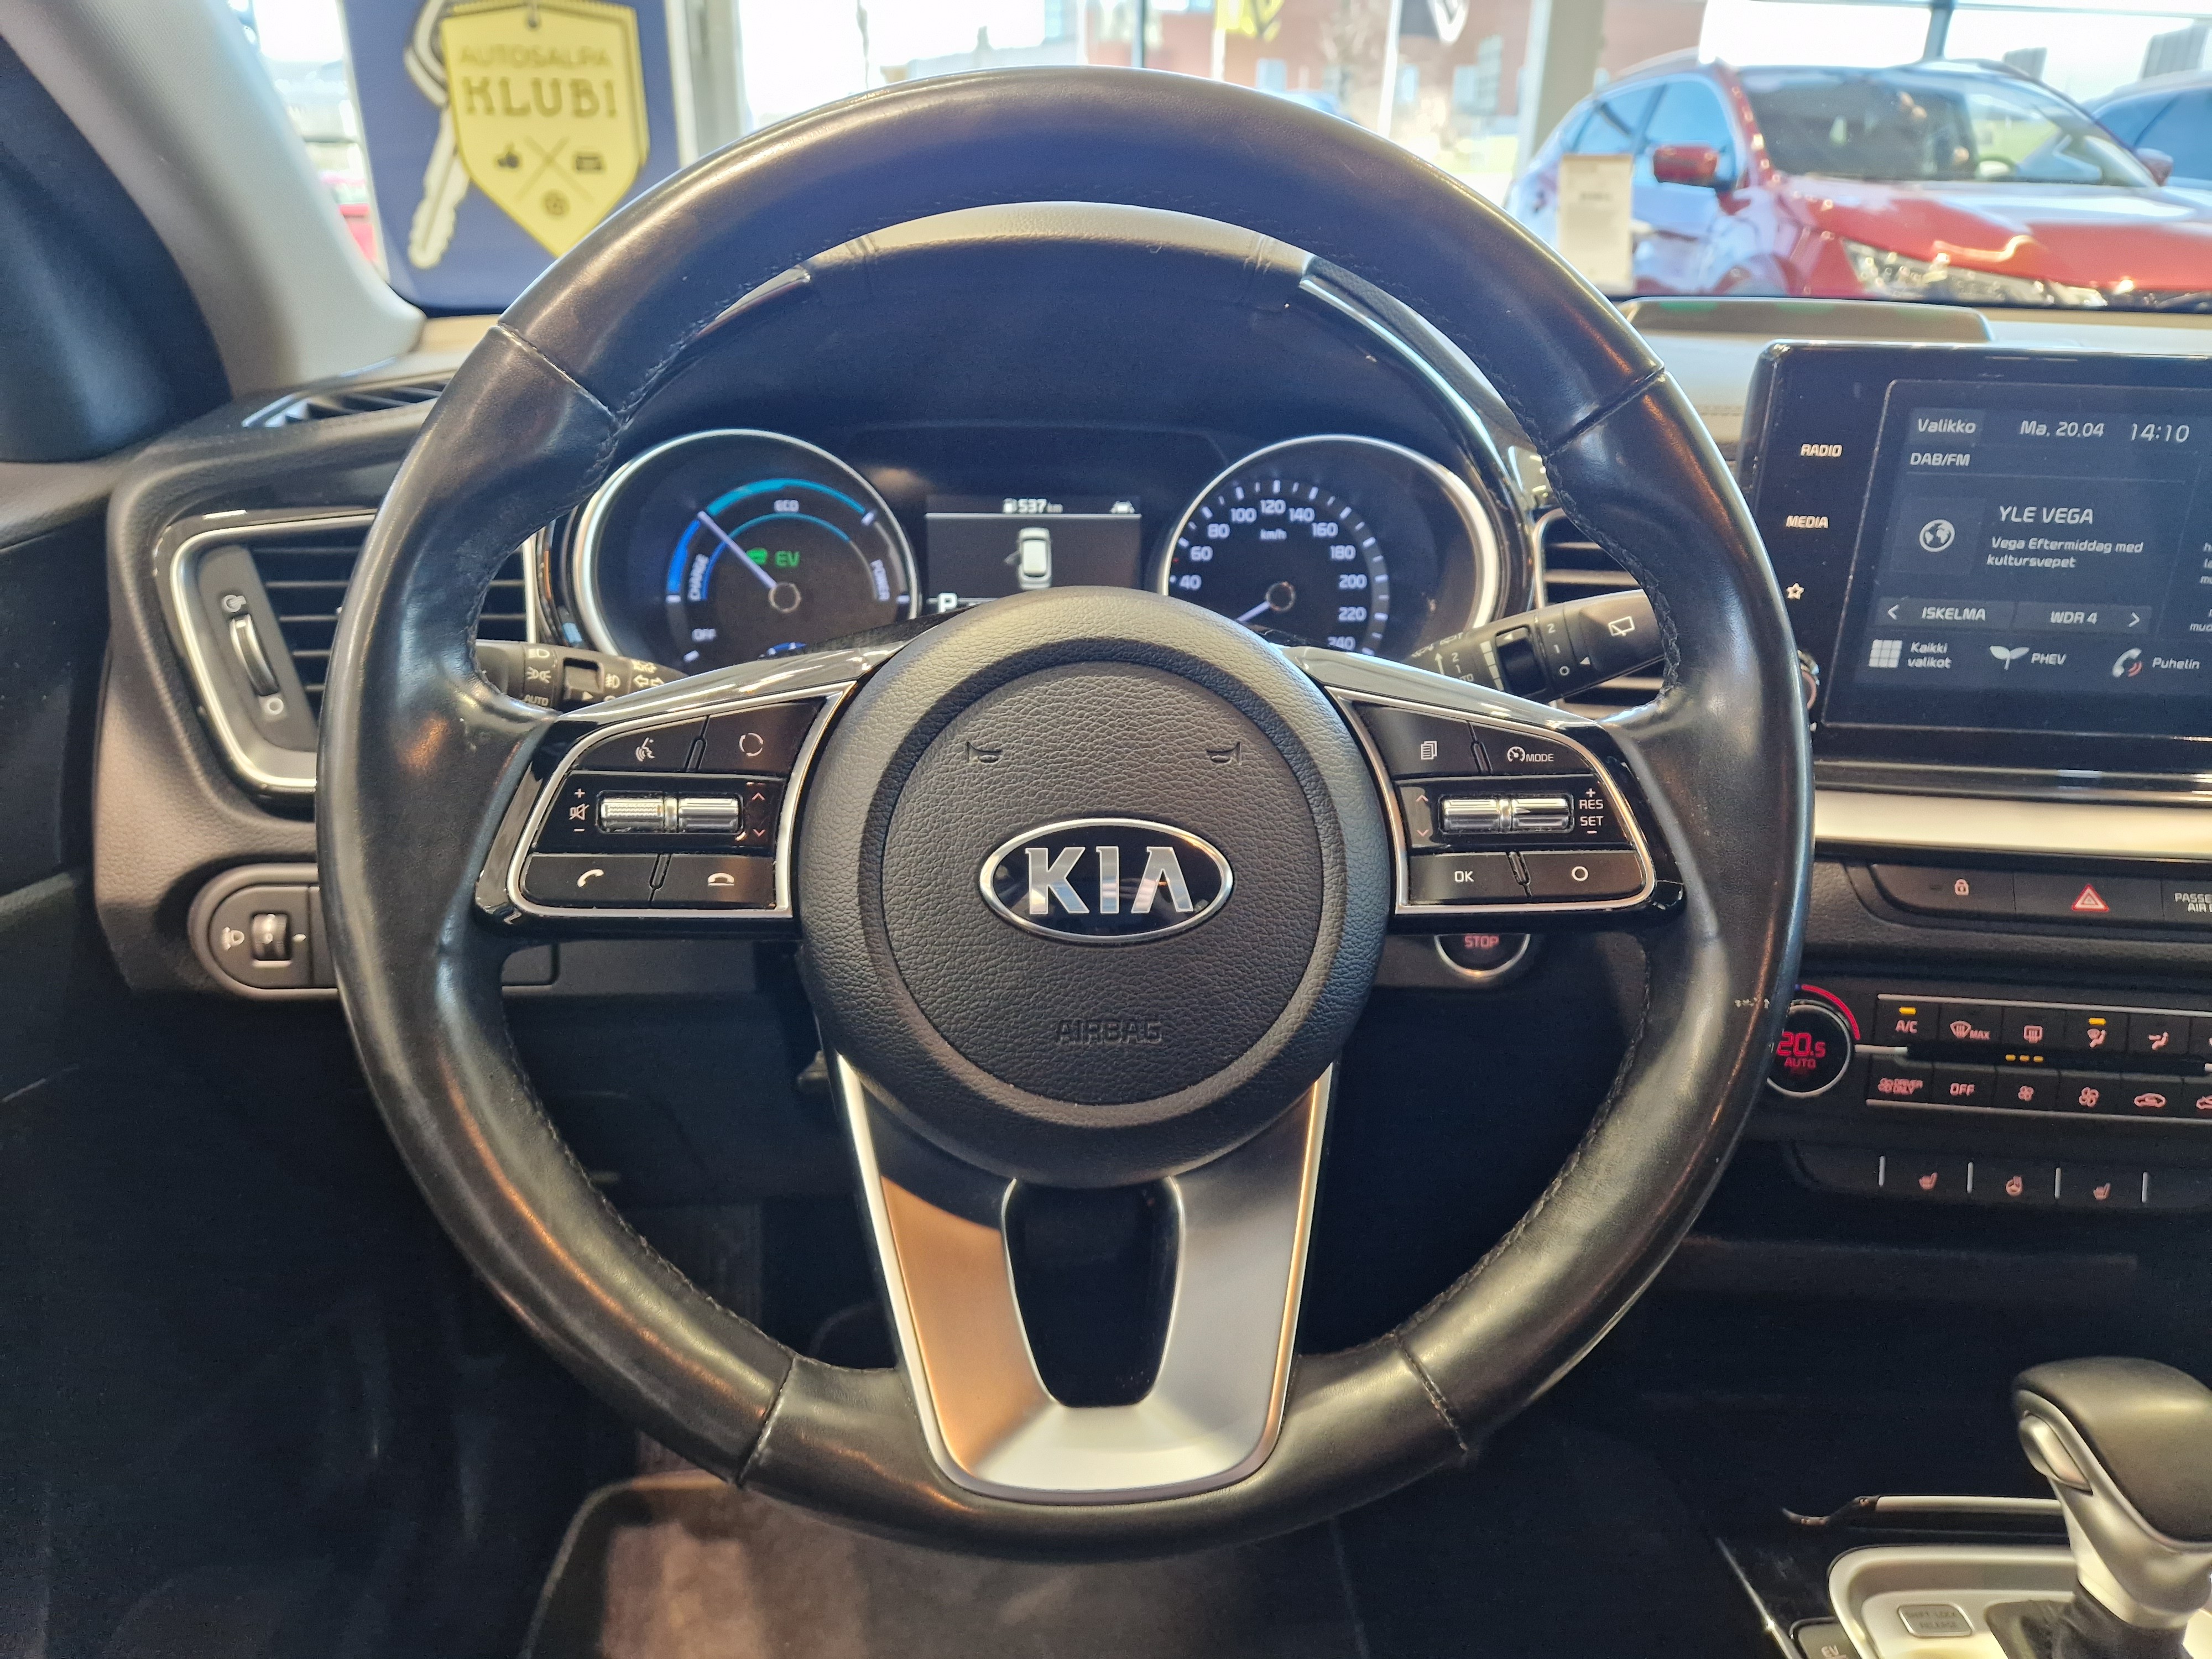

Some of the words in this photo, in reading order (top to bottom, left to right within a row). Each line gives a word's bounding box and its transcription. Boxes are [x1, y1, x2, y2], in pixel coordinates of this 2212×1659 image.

[462, 76, 617, 118] KLUBI
[1918, 418, 1976, 434] Valikko
[2020, 420, 2051, 437] Ma.
[2056, 421, 2105, 437] 20.04
[2131, 422, 2190, 443] 14:10
[1800, 444, 1843, 457] RADIO
[1910, 452, 1971, 467] DAB/FM
[774, 499, 800, 513] ECO
[1018, 498, 1047, 513] 537
[1047, 502, 1063, 513] km
[1260, 499, 1286, 514] 120
[1230, 508, 1258, 523] 100
[1288, 507, 1315, 522] 140
[1785, 515, 1829, 529] MEDIA
[1999, 505, 2037, 523] YLE
[2042, 507, 2094, 525] VEGA
[1207, 523, 1230, 539] 80
[1260, 528, 1287, 540] km/h
[1311, 522, 1339, 538] 160
[1330, 545, 1357, 560] 180
[1991, 536, 2026, 551] Vega
[2028, 537, 2112, 554] Eftermiddag
[2115, 541, 2144, 554] med
[775, 551, 800, 567] EV
[1190, 545, 1213, 561] 60
[1986, 554, 2077, 569] kultursvepet
[1179, 575, 1202, 590] 40
[1338, 574, 1368, 589] 200
[938, 592, 957, 612] P
[1338, 607, 1367, 622] 220
[1922, 606, 1986, 621] ISKELMA
[2051, 611, 2084, 624] WDR
[2087, 612, 2098, 624] 4
[692, 628, 717, 642] OFF
[1547, 623, 1556, 634] 2
[1553, 644, 1560, 654] 1
[1911, 641, 1948, 654] Kaikki
[1451, 653, 1459, 662] 2
[1908, 656, 1952, 669] valikot
[2031, 653, 2067, 665] PHEV
[2152, 657, 2200, 670] Puhelin
[524, 693, 549, 706] AUTO
[1526, 753, 1554, 762] MODE
[1579, 800, 1604, 810] RES
[1580, 816, 1604, 827] SET
[1025, 846, 1194, 914] KIA
[1454, 870, 1474, 883] OK
[2188, 902, 2206, 913] AIR
[1464, 935, 1499, 949] STOP
[1057, 1020, 1162, 1044] AIRBAG
[1895, 1020, 1918, 1033] A/C
[1969, 1030, 1991, 1040] MAX
[1776, 1031, 1826, 1058] 20.5
[1784, 1057, 1816, 1069] AUTO
[1950, 1083, 1976, 1095] OFF
